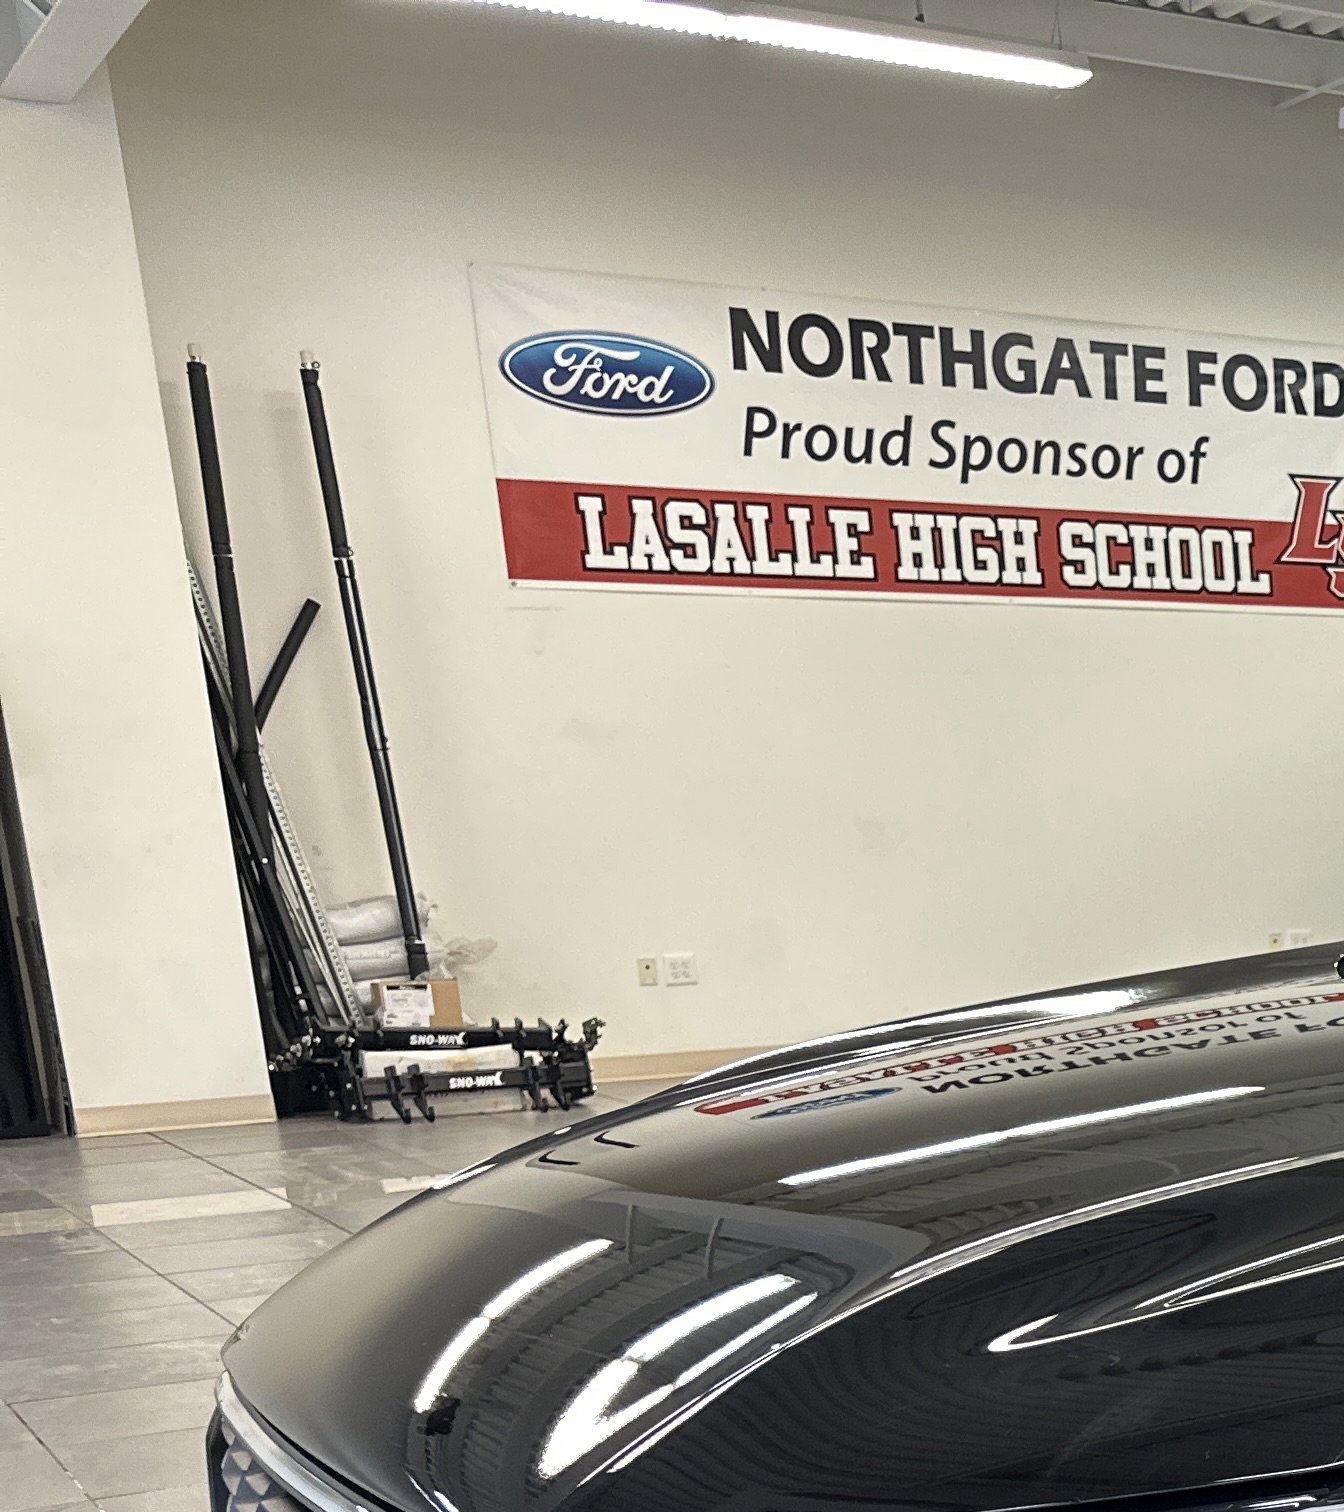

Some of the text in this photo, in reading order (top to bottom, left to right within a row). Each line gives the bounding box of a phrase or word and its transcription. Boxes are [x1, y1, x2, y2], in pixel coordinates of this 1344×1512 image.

[542, 342, 675, 404] Ford
[728, 306, 1168, 405] NORTHGATE
[743, 405, 1210, 485] Proud Sponsor of
[574, 491, 1273, 597] LASALLE HIGH SCHOOL
[409, 1032, 467, 1046] SNO-WAY
[448, 1071, 503, 1089] SNO-WAY
